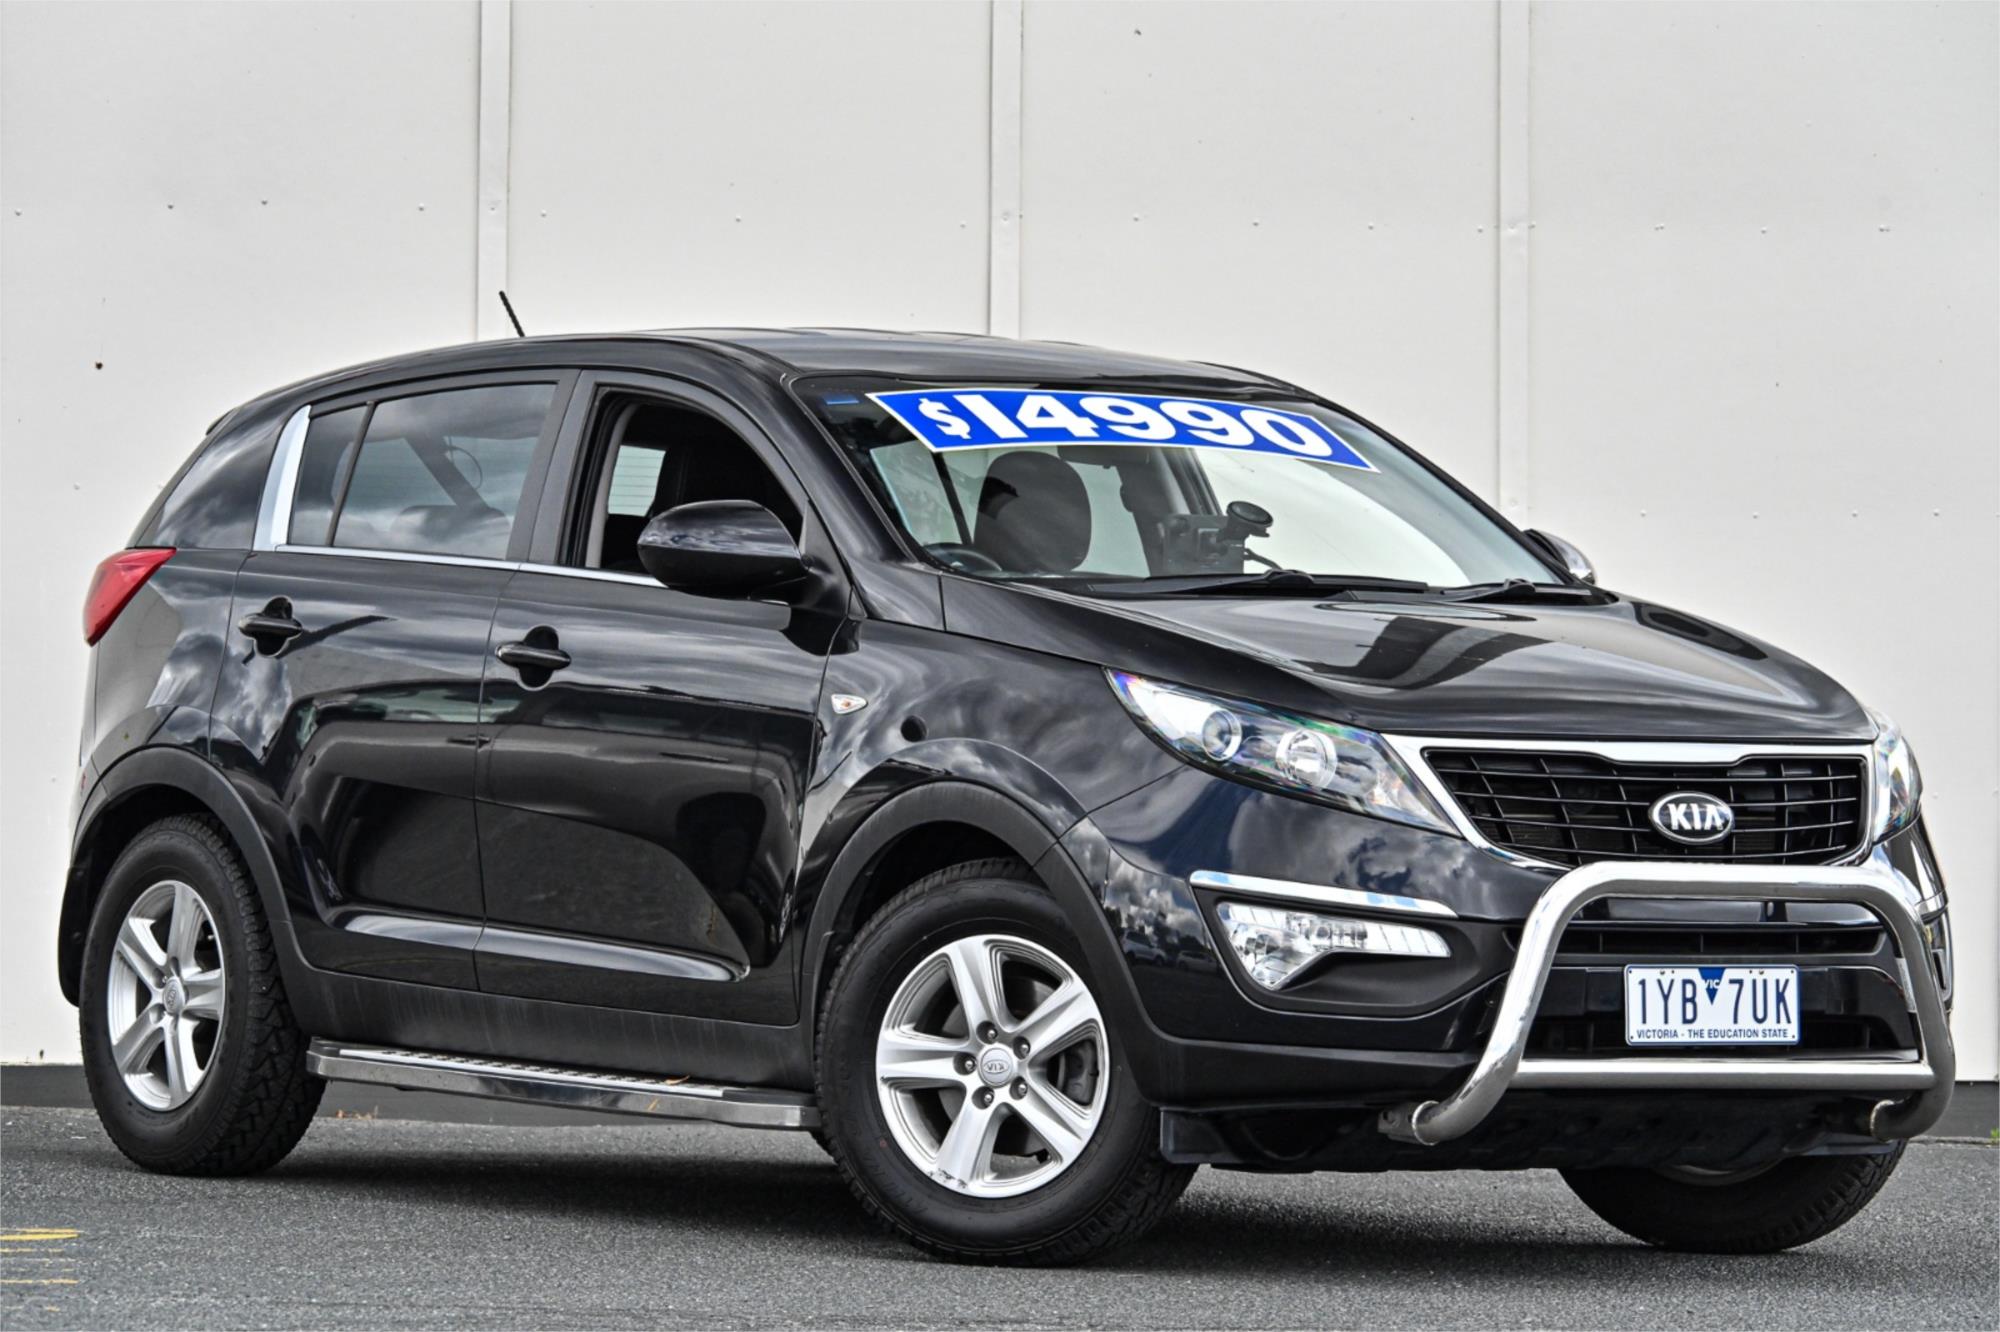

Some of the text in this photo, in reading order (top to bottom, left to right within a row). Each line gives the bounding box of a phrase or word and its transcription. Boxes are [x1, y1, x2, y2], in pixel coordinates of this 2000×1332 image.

[918, 394, 1333, 457] $14990
[1666, 803, 1724, 830] KIA
[1703, 979, 1721, 989] VIC
[1638, 978, 1792, 1025] 1YB 7UK
[1636, 1029, 1679, 1039] VICTORIA
[1688, 1029, 1705, 1039] THE
[1707, 1029, 1759, 1039] EDUCATION
[1762, 1028, 1788, 1038] STATE
